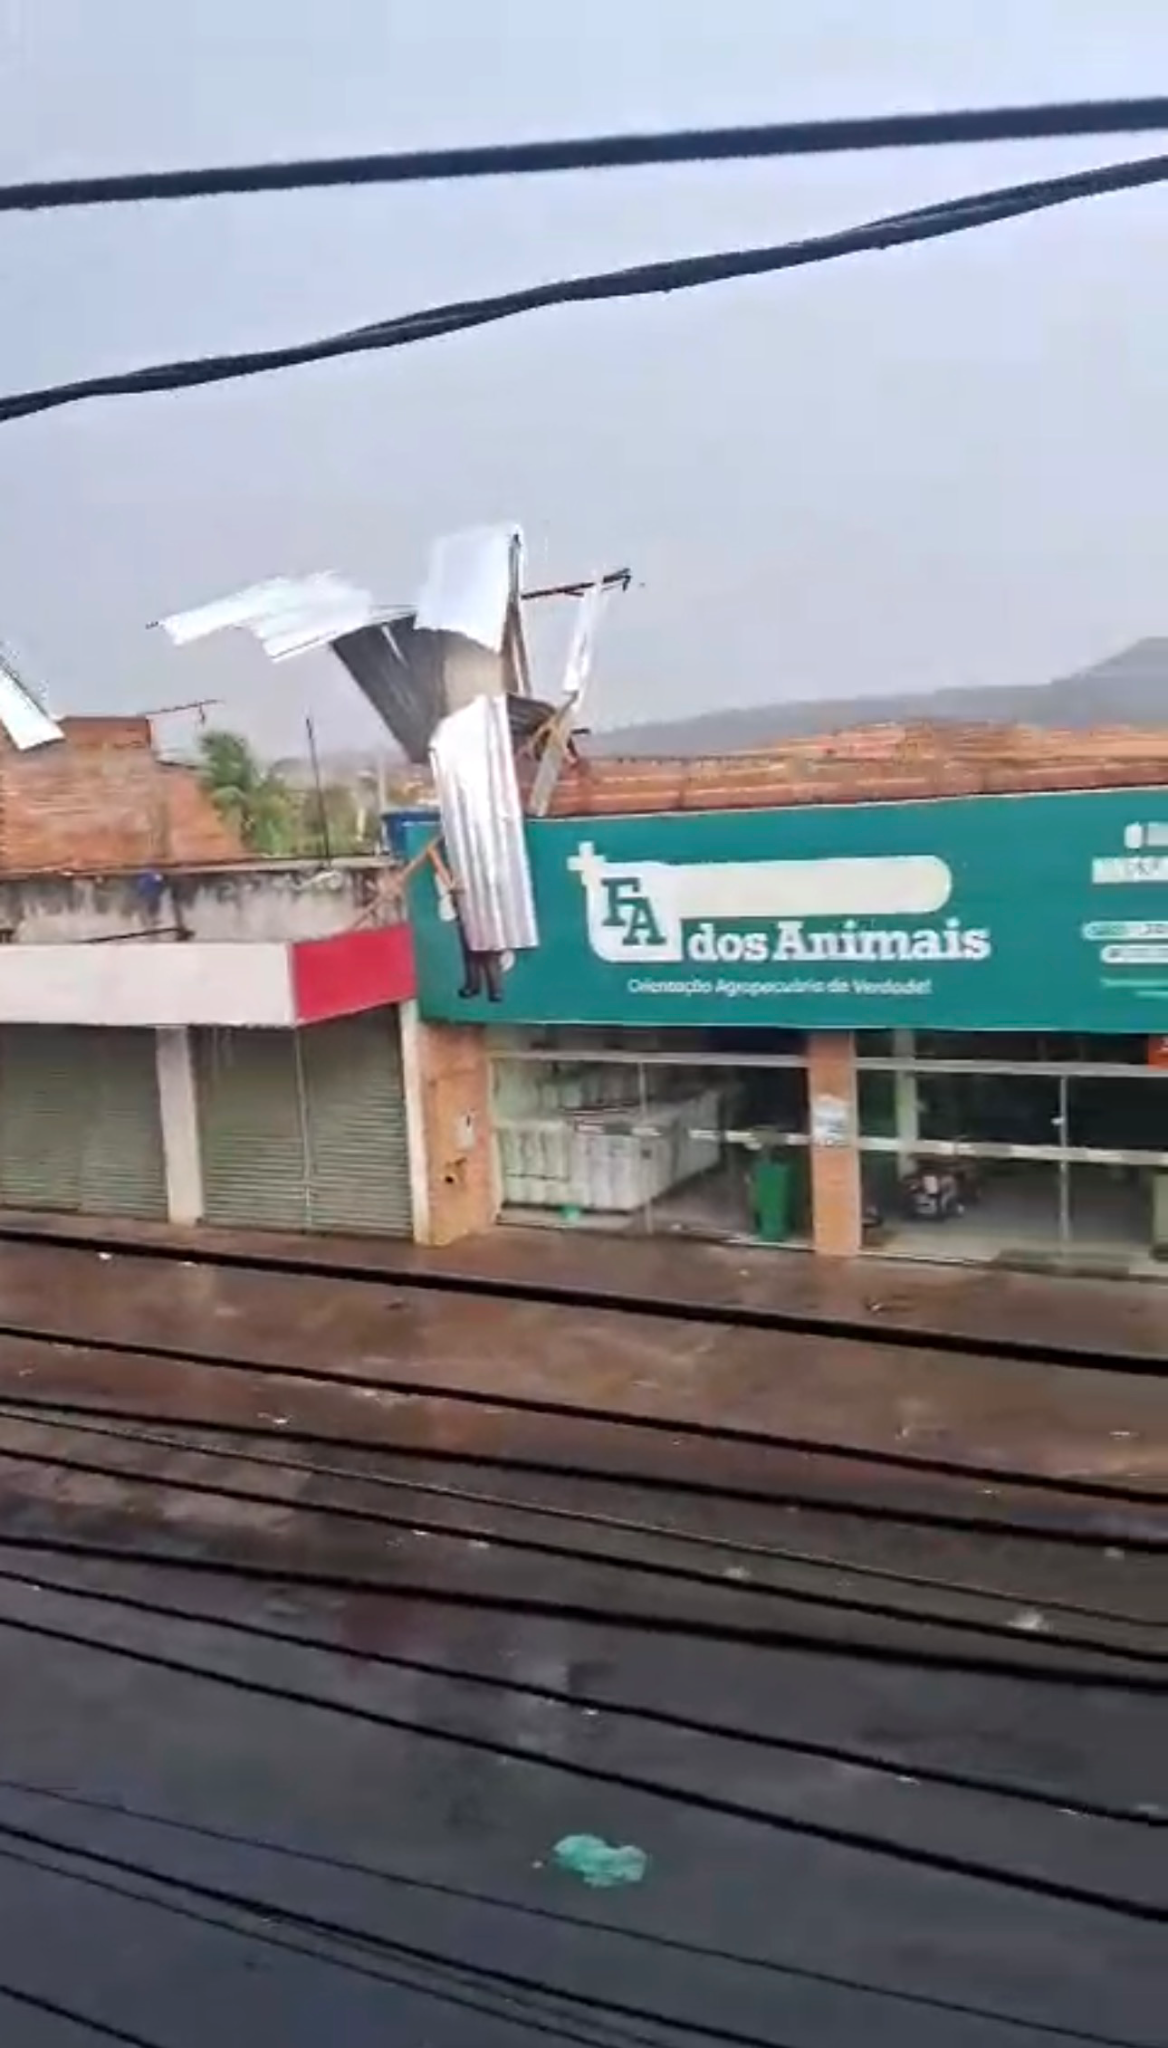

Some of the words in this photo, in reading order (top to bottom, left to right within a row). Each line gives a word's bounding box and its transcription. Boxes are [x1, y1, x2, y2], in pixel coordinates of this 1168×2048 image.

[601, 877, 667, 946] FA
[687, 922, 769, 962] dos
[772, 917, 991, 961] Animais
[827, 977, 850, 993] de
